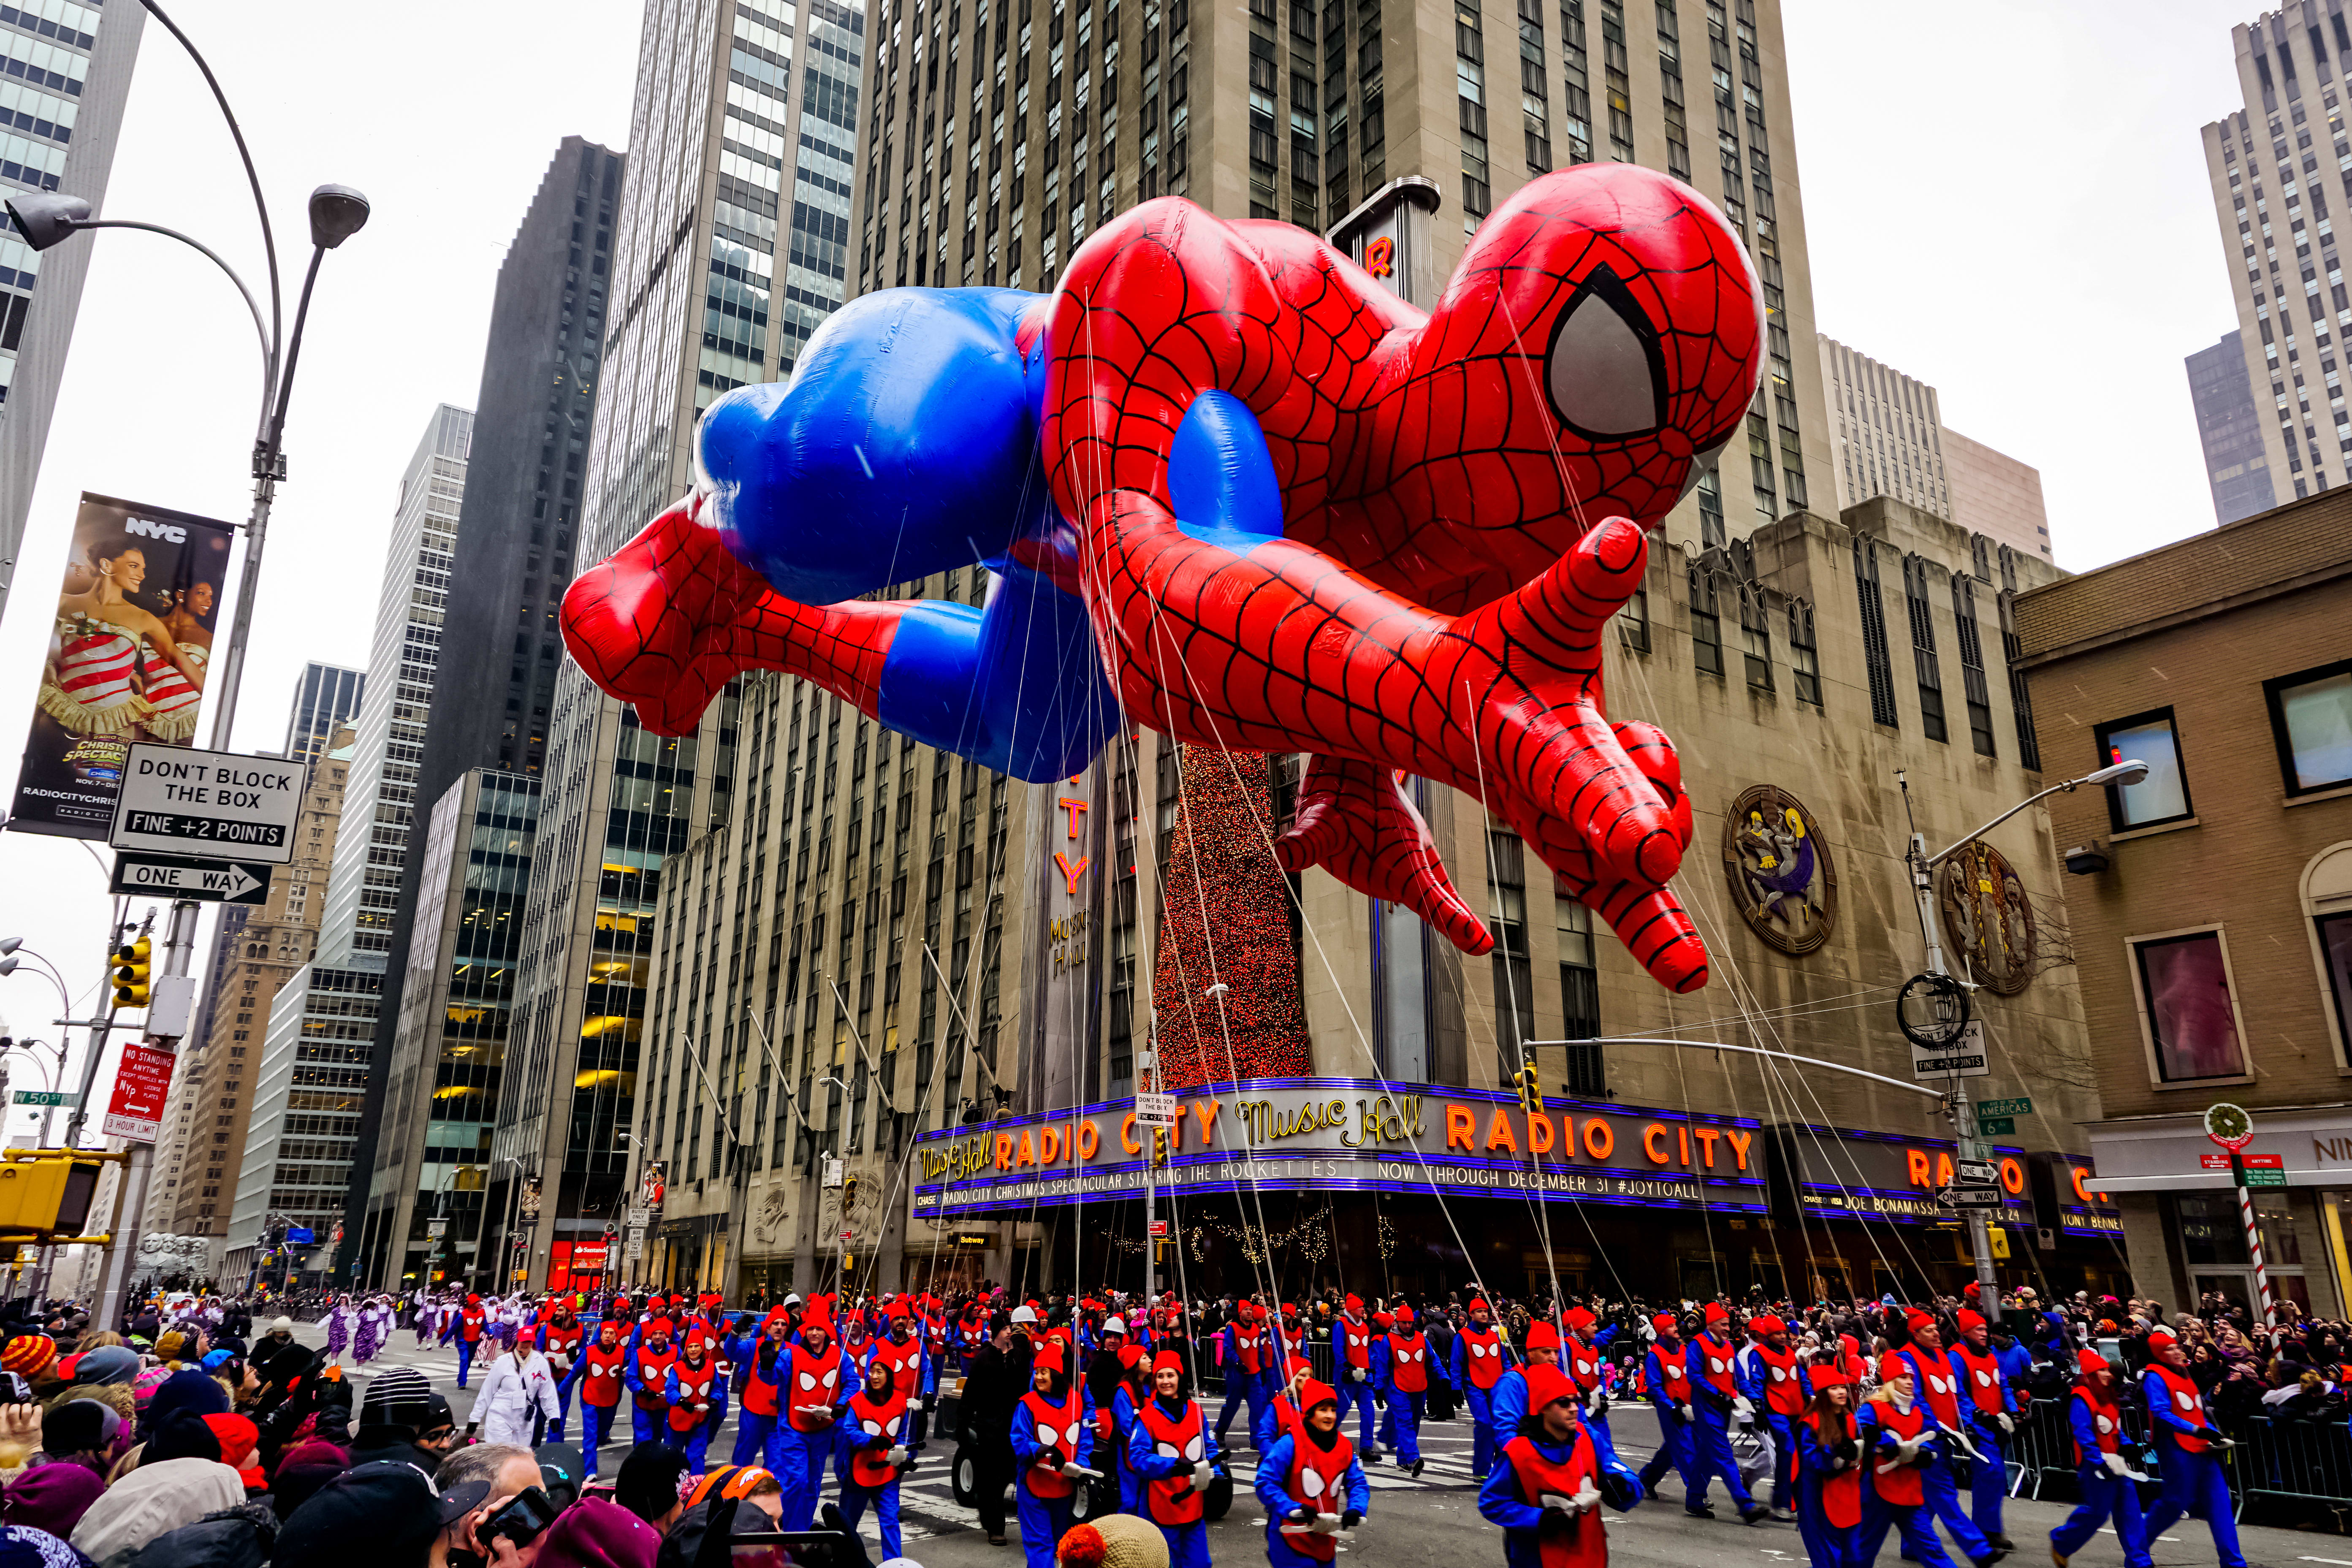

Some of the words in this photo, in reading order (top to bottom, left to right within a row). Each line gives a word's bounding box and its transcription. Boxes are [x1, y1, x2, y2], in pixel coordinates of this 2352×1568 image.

[125, 517, 187, 544] NYC
[139, 760, 208, 781] DON'T
[216, 768, 291, 791] BLOCK
[165, 784, 209, 803] THE
[217, 790, 261, 809] BOX
[132, 814, 173, 833] FINE
[181, 820, 210, 837] +2
[217, 822, 278, 843] POINTS
[136, 867, 182, 885] ONE
[203, 872, 249, 891] WAY
[1049, 909, 1089, 947] MUSIC
[1054, 941, 1088, 978] HALL
[125, 1049, 136, 1059] NO
[138, 1052, 171, 1067] STANDING
[1919, 1061, 1935, 1070] FINE
[133, 1063, 160, 1075] ANYTIME
[137, 1075, 157, 1083] VEHICLES
[15, 1092, 27, 1103] W
[29, 1093, 49, 1104] 50
[1981, 1103, 2028, 1116] AMERICAS
[108, 1119, 113, 1127] 3
[115, 1120, 135, 1131] HOUR
[137, 1124, 155, 1135] LIMIT
[1987, 1122, 1996, 1134] 6
[919, 1144, 958, 1182] Music
[954, 1130, 992, 1180] Hall
[995, 1119, 1099, 1171] RADIO
[1120, 1099, 1220, 1154] CTY
[1235, 1099, 1347, 1145] Music
[1340, 1094, 1427, 1147] Hall
[1446, 1103, 1614, 1160] RADIO
[1644, 1123, 1752, 1170] CITY
[2211, 1134, 2228, 1145] HAPPY
[2230, 1134, 2252, 1146] HOLIDAYS
[1907, 1149, 2023, 1194] RAO
[1963, 1166, 1976, 1176] ONE
[1982, 1168, 1994, 1177] WAY
[918, 1195, 936, 1205] CHASE
[944, 1191, 968, 1204] RADIO
[972, 1187, 991, 1202] CITY
[996, 1181, 1045, 1199] CHRISTMAS
[1051, 1174, 1121, 1194] SPECTACULAR
[1190, 1165, 1211, 1182] THE
[1220, 1160, 1337, 1181] ROCKETTES
[1378, 1162, 1414, 1180] NOW
[1427, 1165, 1499, 1187] THROUGH
[1508, 1172, 1586, 1191] DECEMBER
[1597, 1178, 1609, 1193] 31
[1618, 1181, 1699, 1199] #JOYTOALL
[1942, 1193, 1964, 1202] ONE
[1975, 1192, 1995, 1201] WAY
[1845, 1196, 1867, 1210] JOE
[1874, 1198, 1941, 1215] BONAMASSA
[2008, 1209, 2019, 1221] 24
[961, 1236, 984, 1244] Subway
